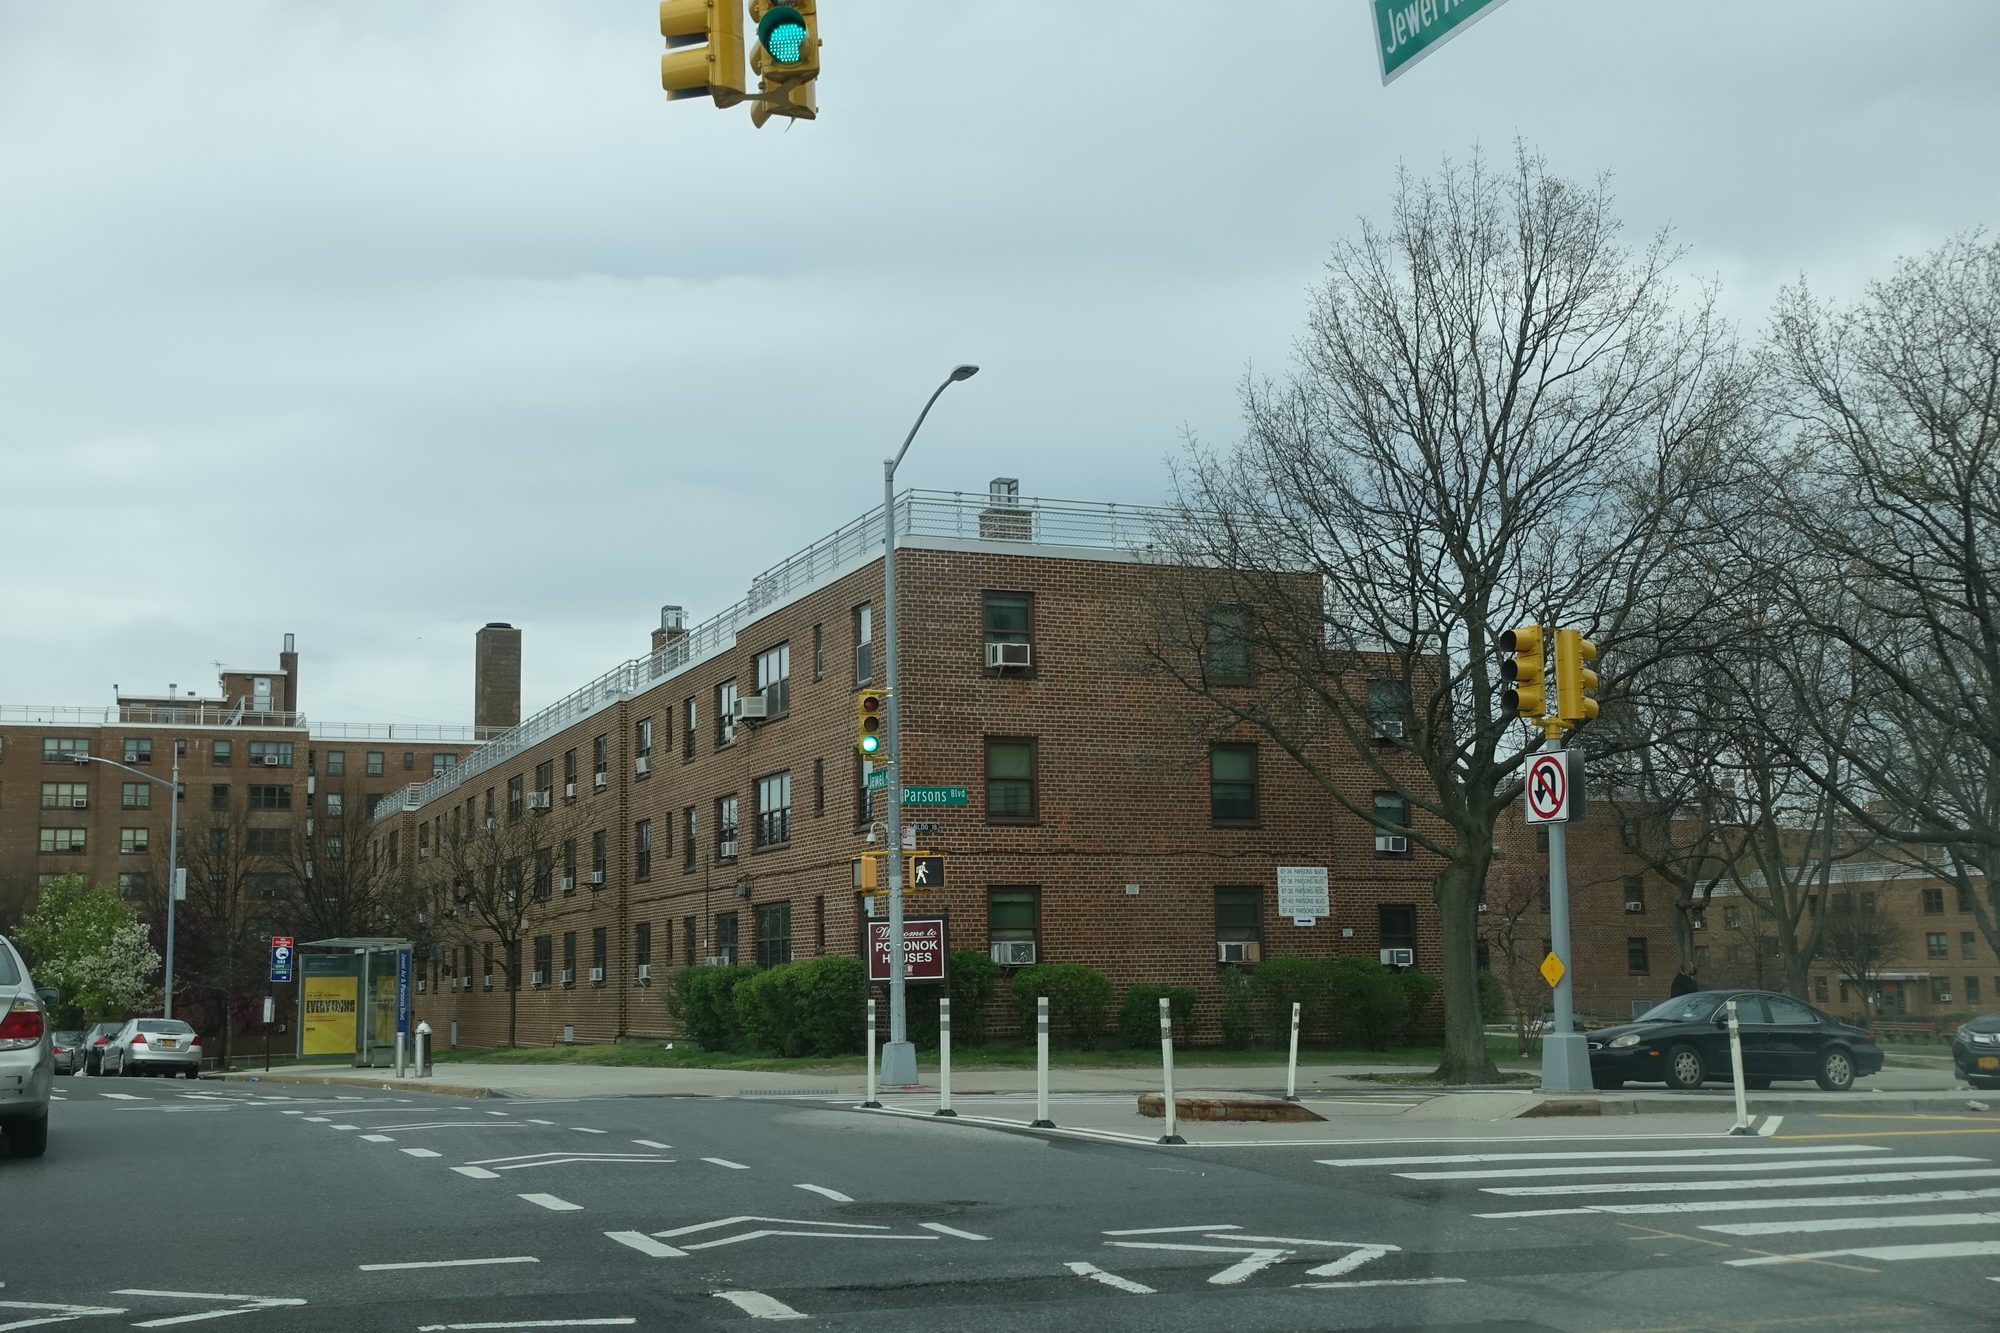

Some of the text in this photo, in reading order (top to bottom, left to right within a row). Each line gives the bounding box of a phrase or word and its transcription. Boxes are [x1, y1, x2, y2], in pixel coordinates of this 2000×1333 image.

[869, 771, 885, 788] Jewel
[904, 788, 966, 802] Parsons Blvd
[875, 926, 938, 938] Wome to
[875, 940, 938, 952] POONOK
[882, 952, 932, 964] HSES
